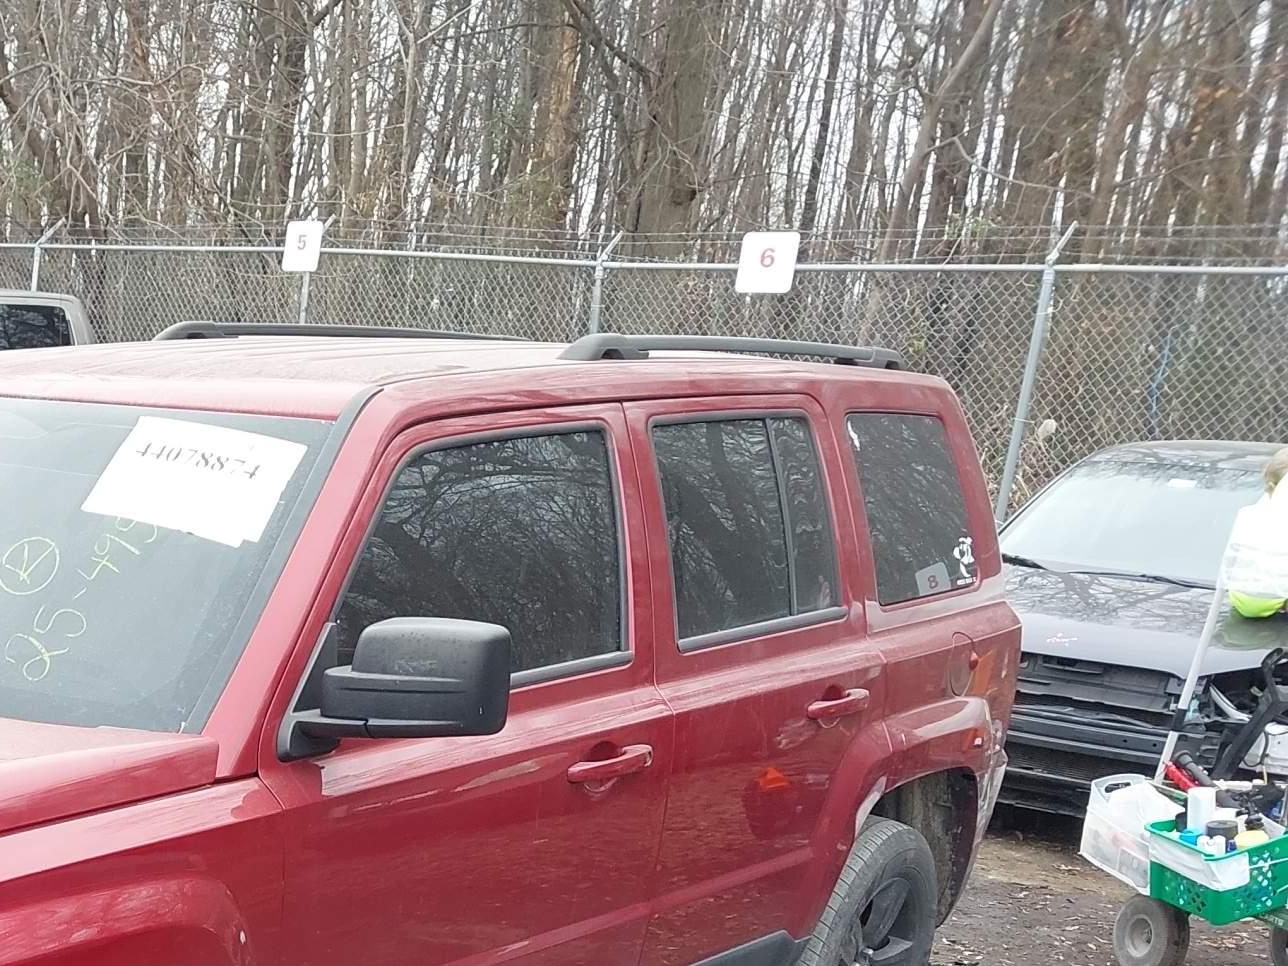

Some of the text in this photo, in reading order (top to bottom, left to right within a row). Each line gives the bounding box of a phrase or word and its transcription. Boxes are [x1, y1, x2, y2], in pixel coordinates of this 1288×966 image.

[297, 234, 307, 250] 5
[760, 247, 776, 268] 6
[135, 442, 261, 479] 44078874
